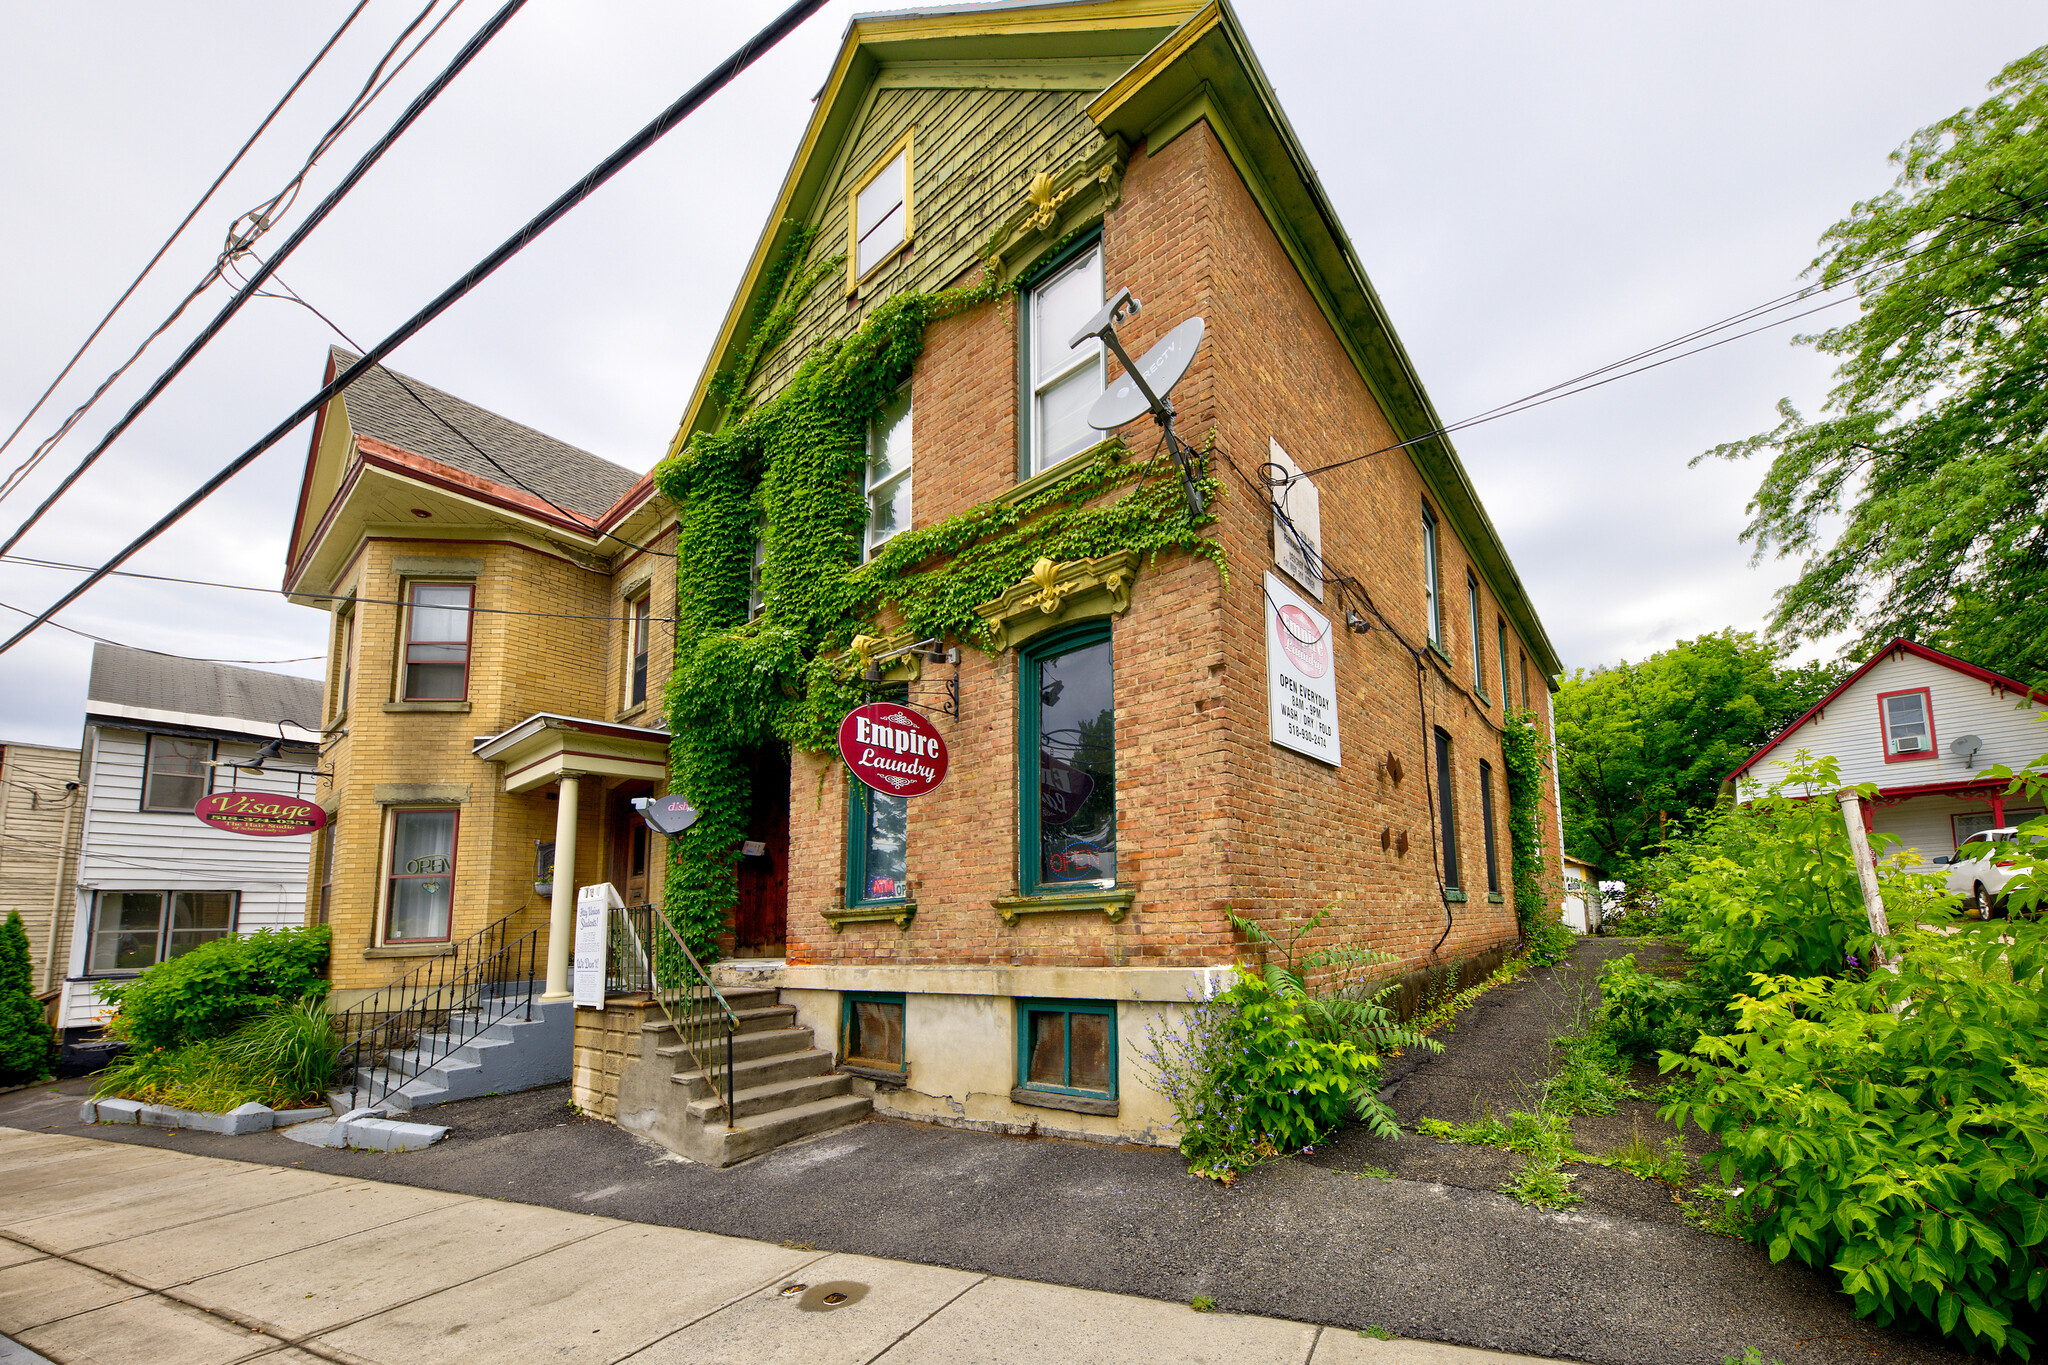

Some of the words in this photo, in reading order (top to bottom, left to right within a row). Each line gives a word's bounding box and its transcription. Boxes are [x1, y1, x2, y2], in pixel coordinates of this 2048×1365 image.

[1131, 341, 1175, 389] RECTV
[1281, 611, 1324, 657] Empire
[1285, 637, 1323, 674] Laundry
[1280, 673, 1298, 694] OPEN
[1299, 684, 1330, 711] EVERYDAY
[1280, 703, 1299, 722] WASH
[1303, 714, 1314, 728] DRY
[1319, 722, 1332, 737] FOLD
[1291, 695, 1305, 711] 8AM
[1309, 704, 1322, 720] 9PM
[855, 715, 940, 760] Empire
[1288, 722, 1327, 748] 518-930-2474
[858, 747, 936, 784] Laundry
[211, 795, 311, 820] Visage
[668, 801, 689, 812] dish
[406, 857, 451, 874] OPEN
[1050, 848, 1100, 872] OPEN
[873, 879, 894, 894] ATM
[896, 884, 906, 896] OP
